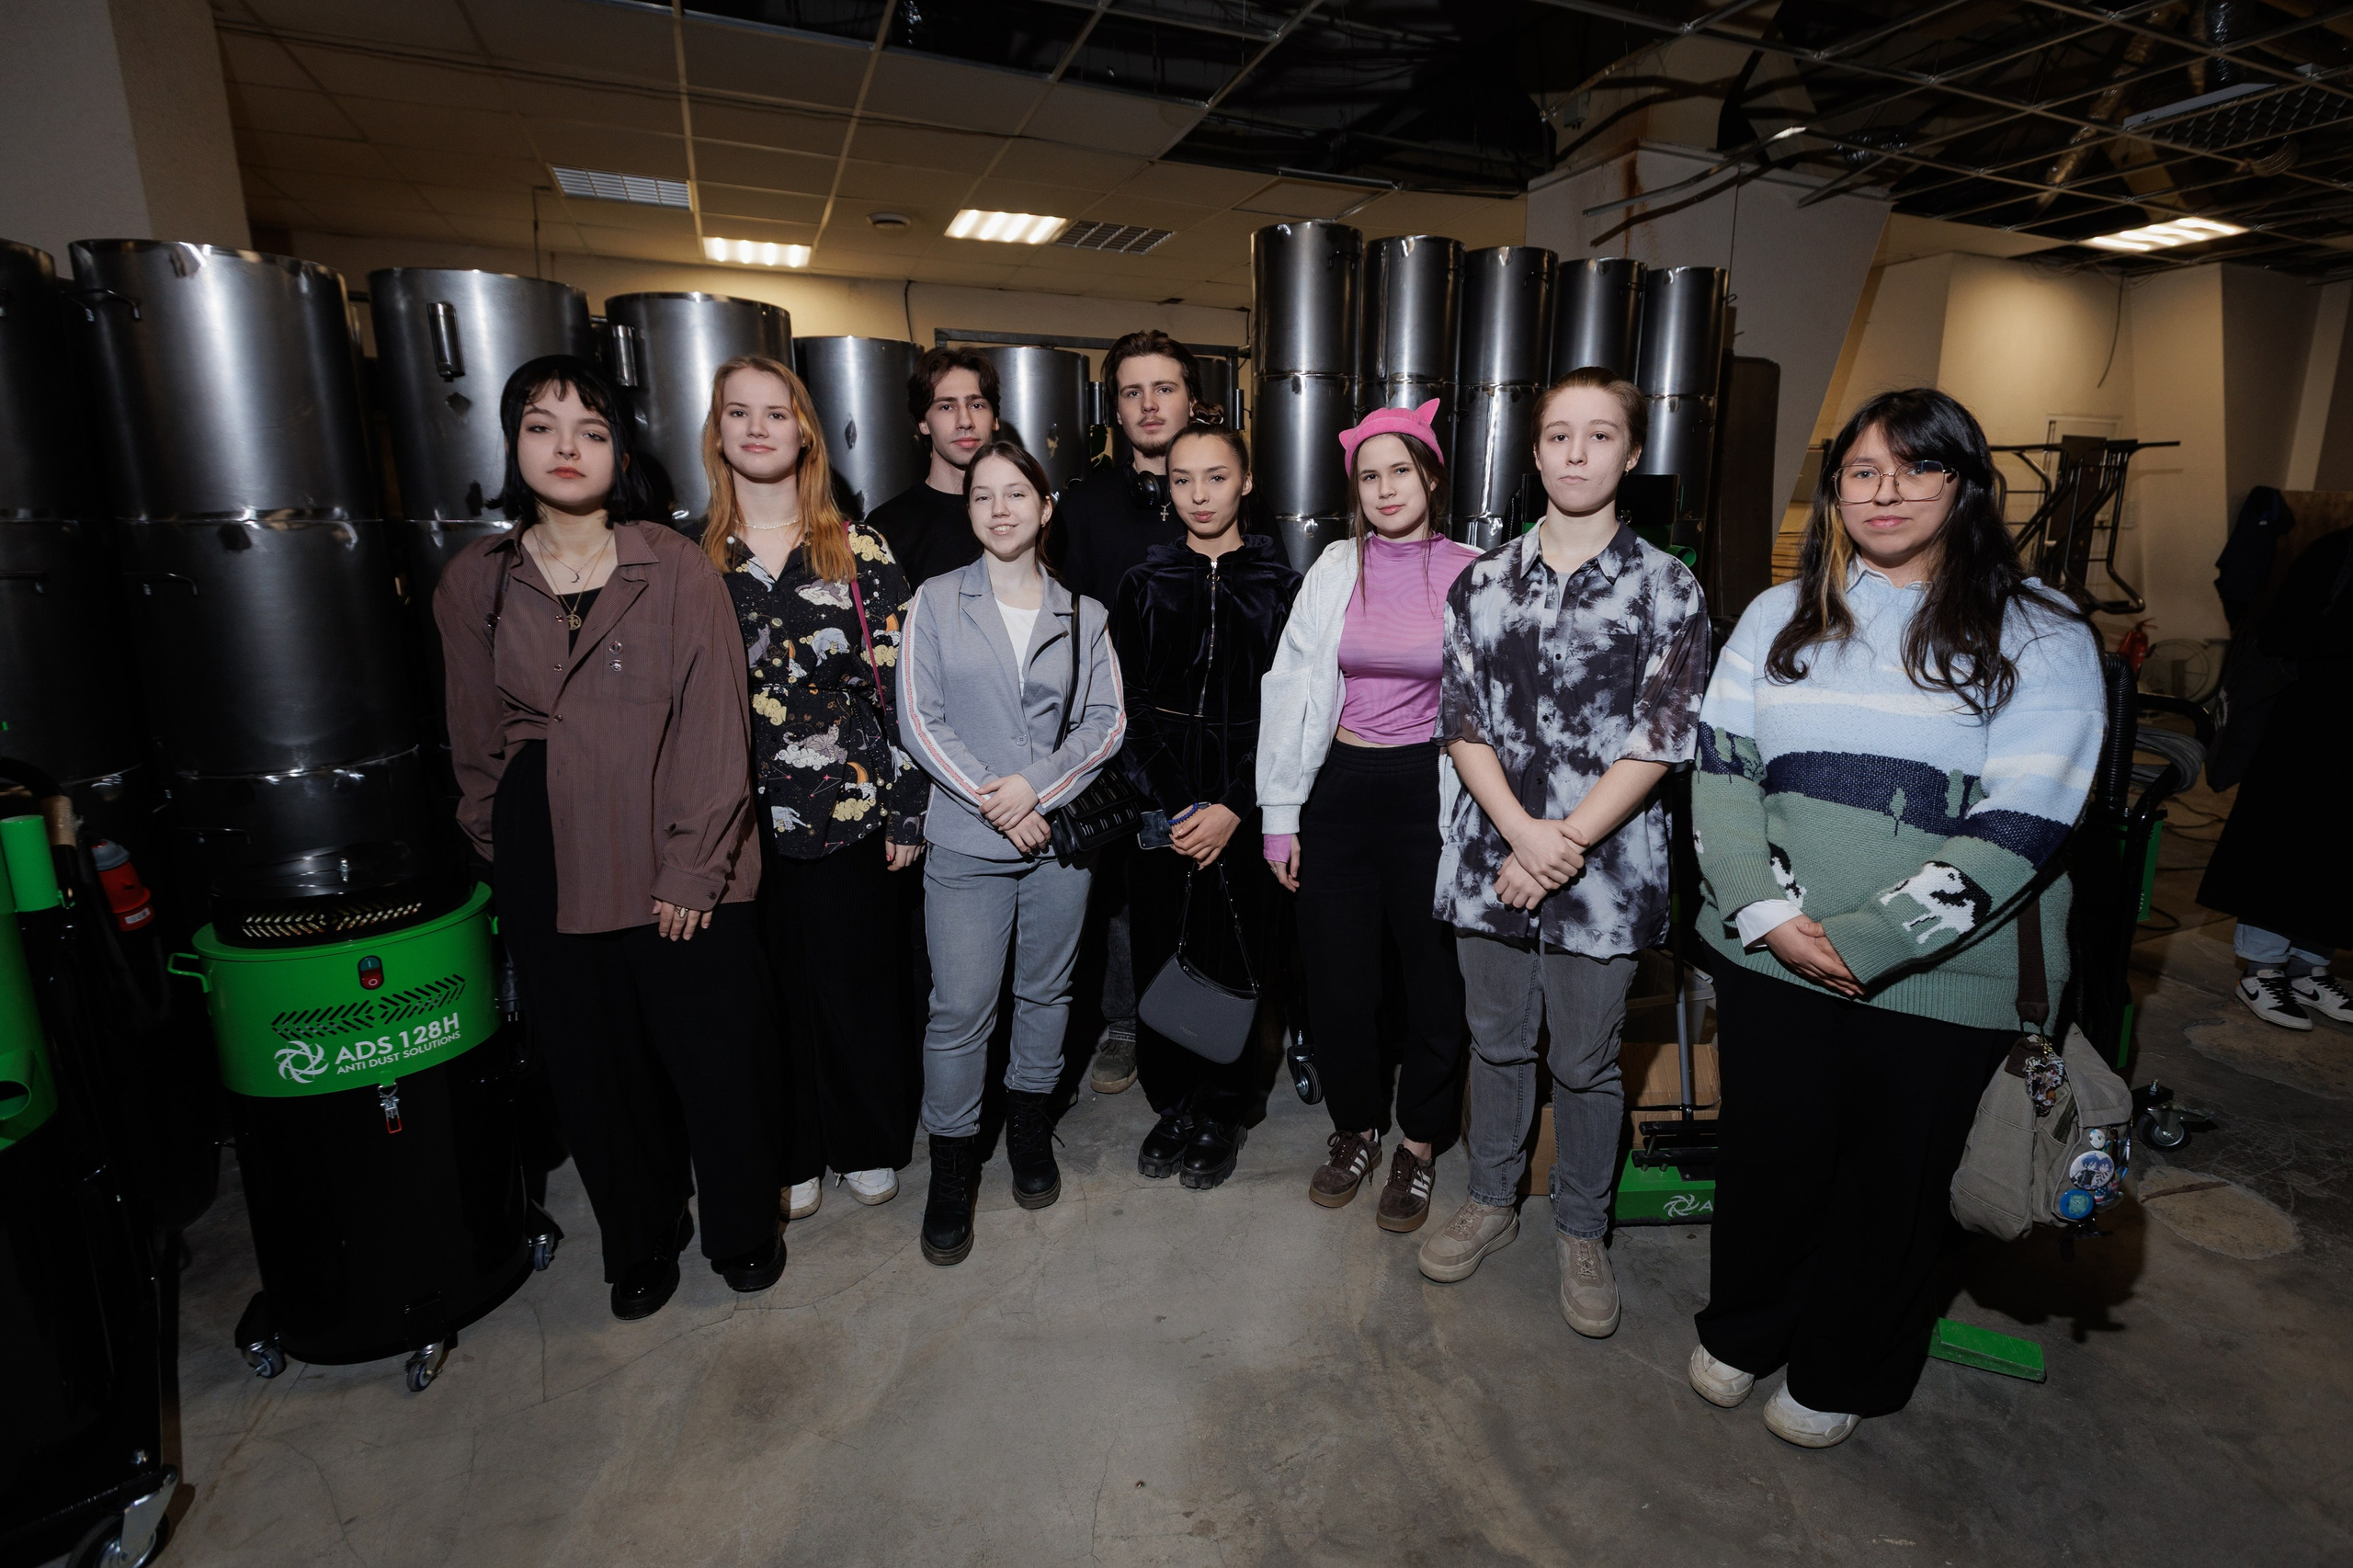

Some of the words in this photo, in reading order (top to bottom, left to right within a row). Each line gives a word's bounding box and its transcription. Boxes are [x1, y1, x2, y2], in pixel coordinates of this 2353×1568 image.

[335, 1036, 393, 1065] ADS
[398, 1012, 460, 1048] 128H
[336, 1061, 367, 1074] ANTI
[369, 1052, 400, 1068] DUST
[403, 1030, 460, 1058] SOLUTIONS
